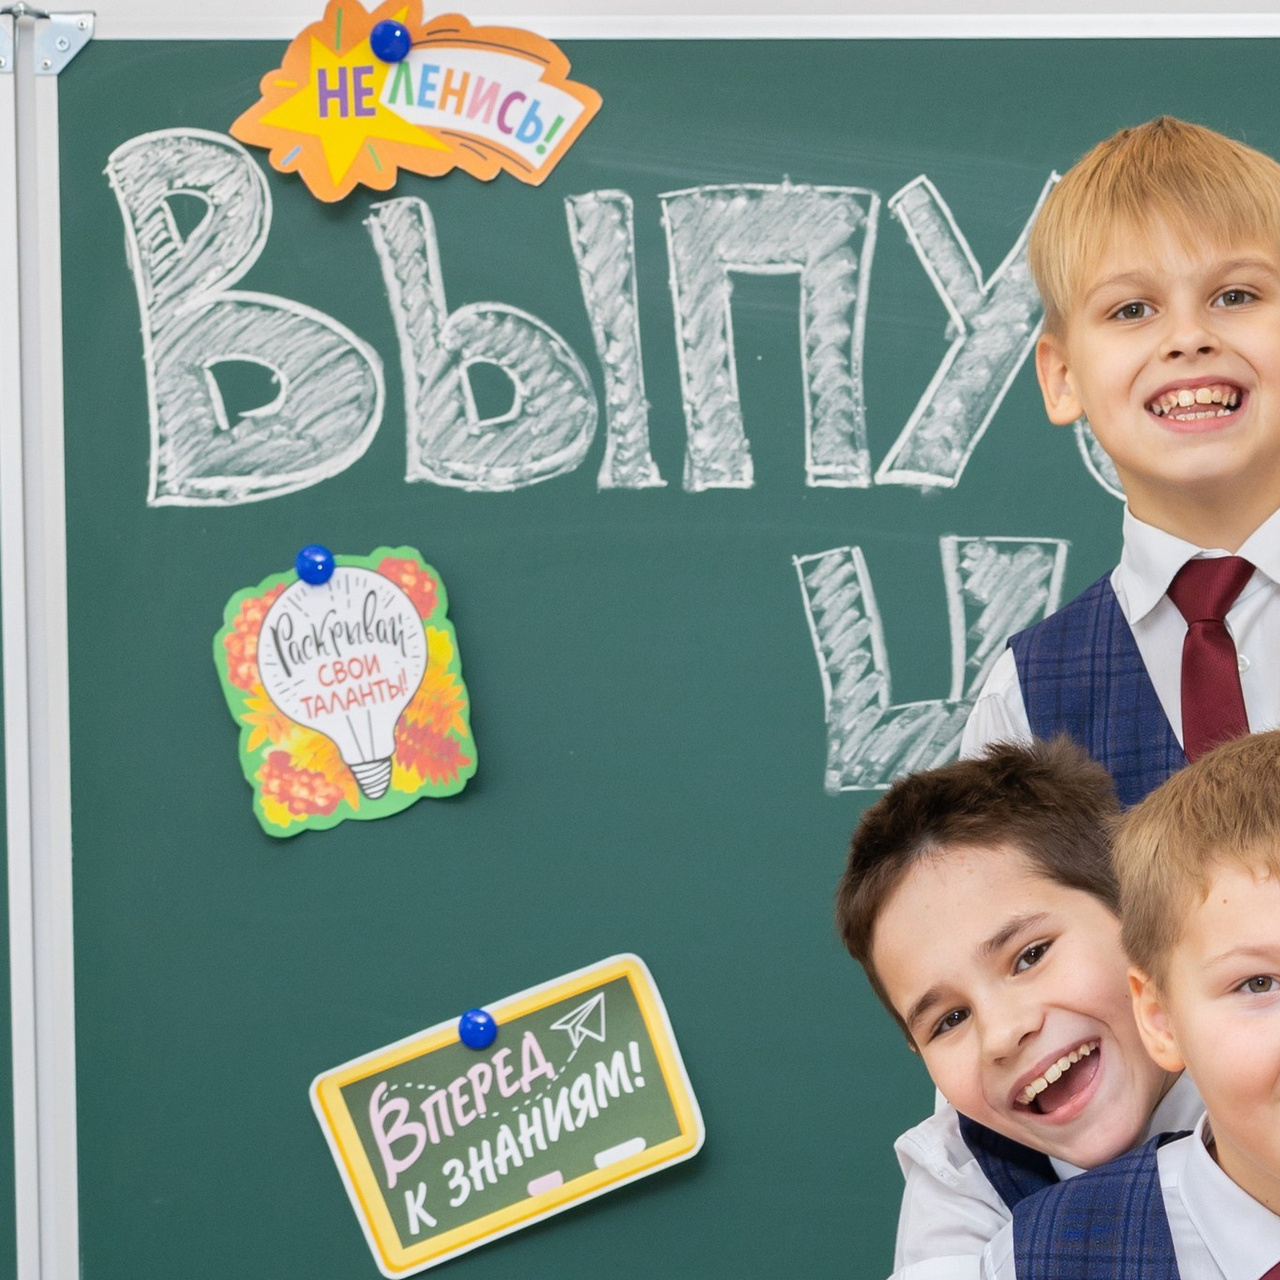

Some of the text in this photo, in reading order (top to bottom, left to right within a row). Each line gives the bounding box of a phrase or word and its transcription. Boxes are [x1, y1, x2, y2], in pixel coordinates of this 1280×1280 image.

[317, 61, 565, 155] НЕ ЛЕНИСЬ!
[270, 590, 407, 677] Раскрывай
[317, 653, 381, 688] СВОИ
[300, 668, 408, 719] ТАЛАНТЫ!
[442, 1041, 646, 1208] ЗНАНИЯМ!
